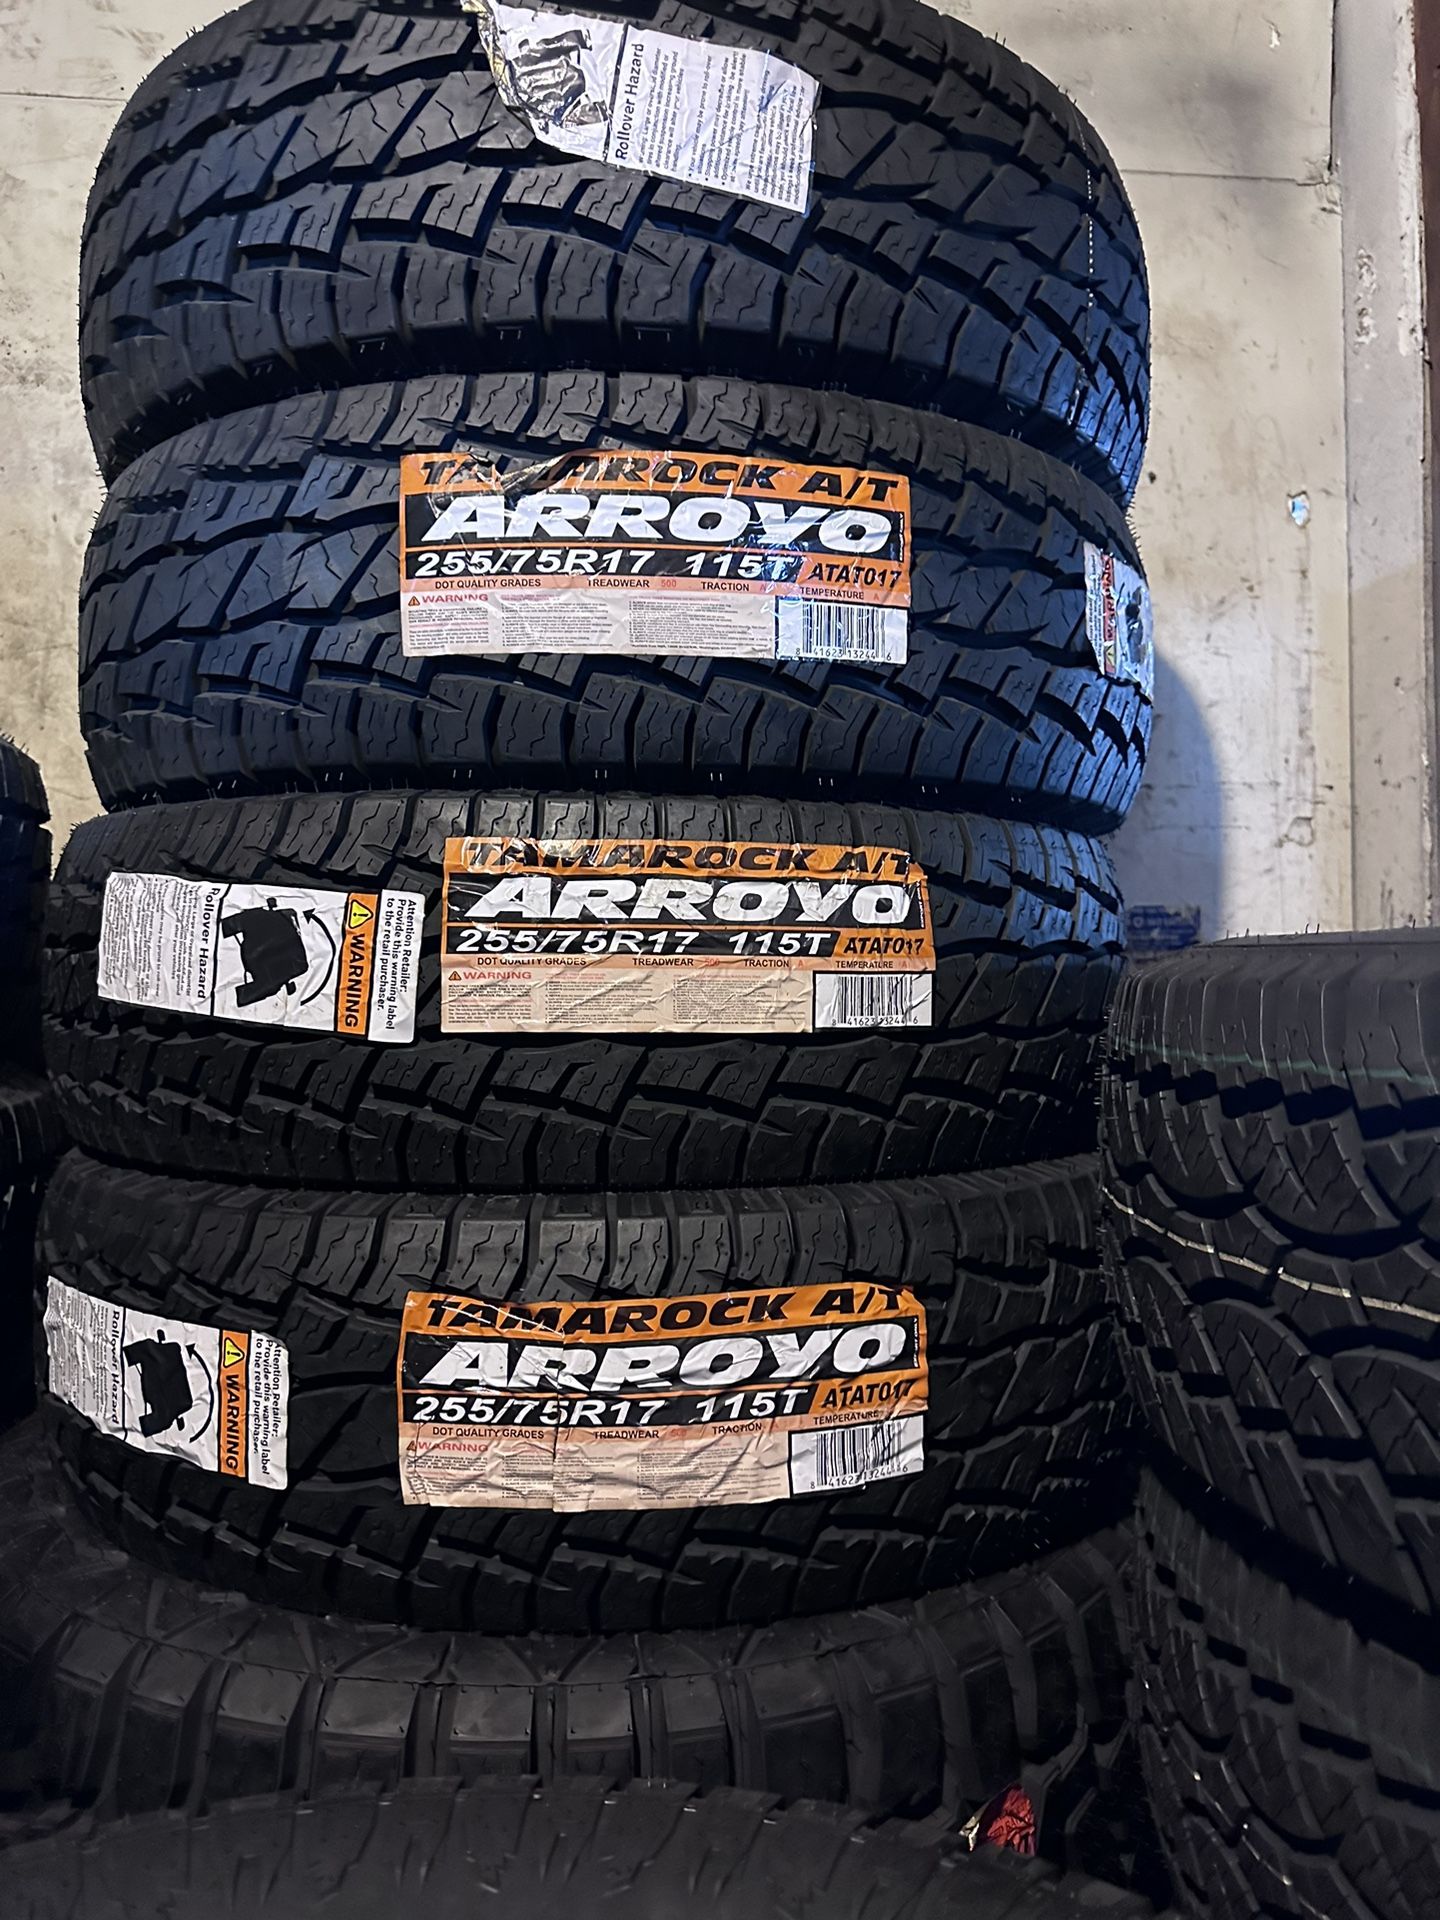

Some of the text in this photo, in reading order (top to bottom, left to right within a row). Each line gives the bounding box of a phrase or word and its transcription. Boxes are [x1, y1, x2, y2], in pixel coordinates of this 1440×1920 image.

[615, 42, 644, 160] Rollover Hazard
[421, 455, 899, 502] TAAROCK A/T
[421, 494, 892, 554] ARROYO
[415, 549, 902, 588] 255/75R17 115T ATAT017
[435, 580, 455, 589] DOT
[457, 579, 498, 589] QUALITY
[500, 578, 541, 588] GRADES
[587, 578, 650, 588] TREADWEAR
[661, 580, 676, 588] 500
[701, 581, 749, 591] TRACTION
[801, 587, 864, 600] TEMPERATURE
[813, 649, 844, 658] 41623
[847, 650, 876, 660] 13244
[886, 653, 892, 661] 6
[830, 851, 911, 875] A/T
[464, 877, 911, 924] ARROYO
[197, 887, 220, 998] Rollover Hazard
[377, 898, 394, 1010] to the retail purchaser.
[385, 898, 406, 1029] Provide this warning label
[399, 899, 416, 992] Attention Retailer:
[456, 929, 924, 955] 255/75R17 115T ATAT017
[477, 957, 497, 966] DOT
[500, 957, 544, 967] QUALITY
[545, 957, 587, 966] GRADES
[633, 958, 694, 966] TREADWEAR
[744, 959, 789, 968] TRACTION
[836, 960, 893, 969] TEMPERATURE
[345, 933, 365, 1028] WARNING
[463, 971, 531, 980] WARNING
[848, 1017, 876, 1026] 41623
[913, 1016, 918, 1024] 6
[428, 1286, 904, 1334] TAMAROCK A/T
[110, 1310, 119, 1423] Rollover Hazard
[254, 1351, 262, 1368] the
[256, 1338, 262, 1348] to
[418, 1323, 907, 1391] ARROYO
[260, 1339, 273, 1474] Provide this warning label
[271, 1342, 281, 1437] Attention Retailer:
[413, 1379, 915, 1426] 255/75R17 115T ATAT017
[225, 1374, 240, 1471] WARNING
[433, 1426, 453, 1436] DOT
[456, 1427, 500, 1438] QUALITY
[502, 1428, 544, 1440] GRADES
[593, 1429, 659, 1439] TREADWEAR
[712, 1423, 762, 1435] TRACTION
[813, 1409, 880, 1426] TEMPERATURE
[418, 1441, 489, 1453] WARNING
[810, 1481, 816, 1489] 8
[902, 1464, 909, 1473] 6
